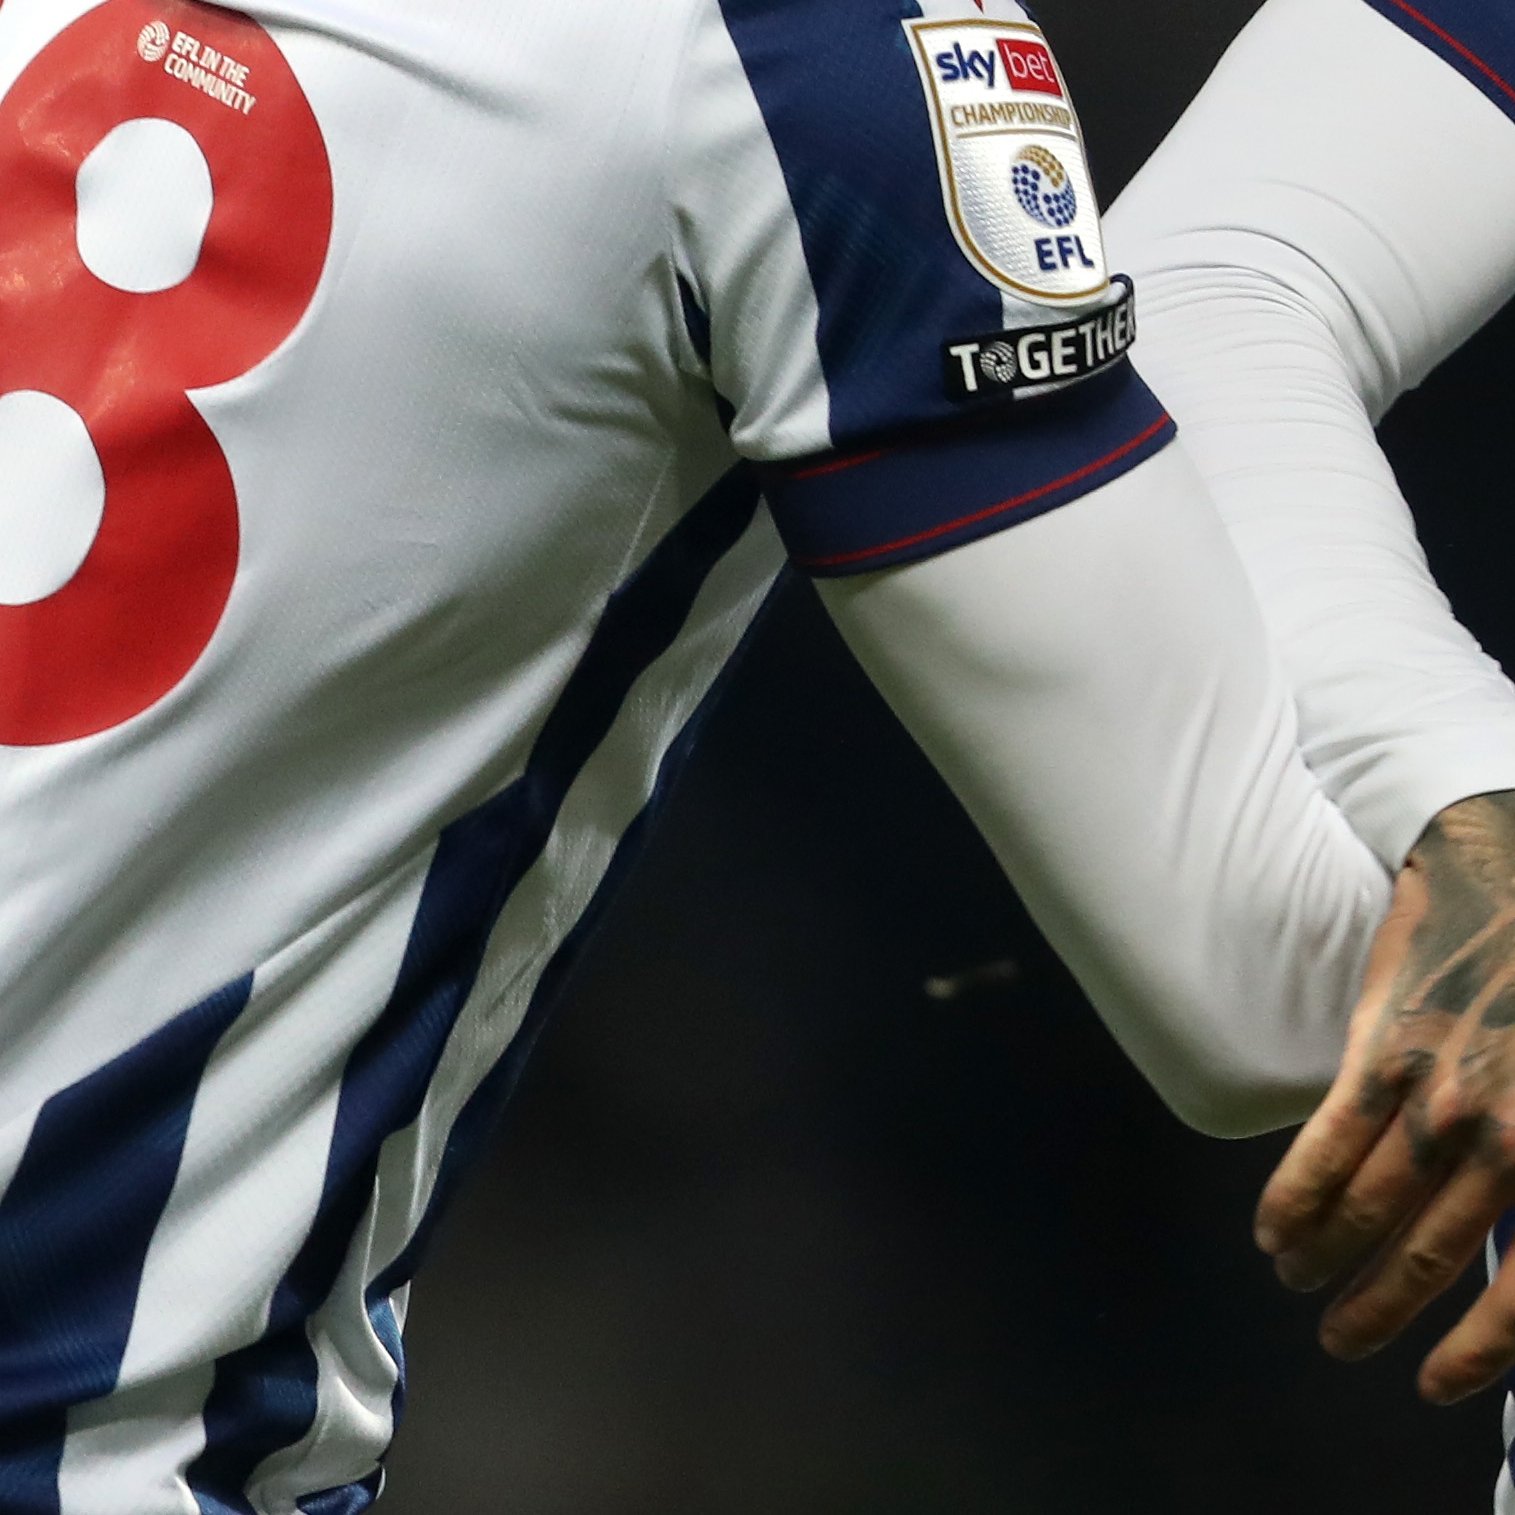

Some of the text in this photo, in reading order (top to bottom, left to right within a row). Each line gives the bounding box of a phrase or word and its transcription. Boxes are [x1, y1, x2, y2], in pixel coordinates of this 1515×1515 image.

[164, 52, 257, 115] COMMUNITY
[171, 30, 250, 88] EFL IN THE
[936, 42, 1056, 89] sky bet
[1034, 236, 1094, 271] EFL
